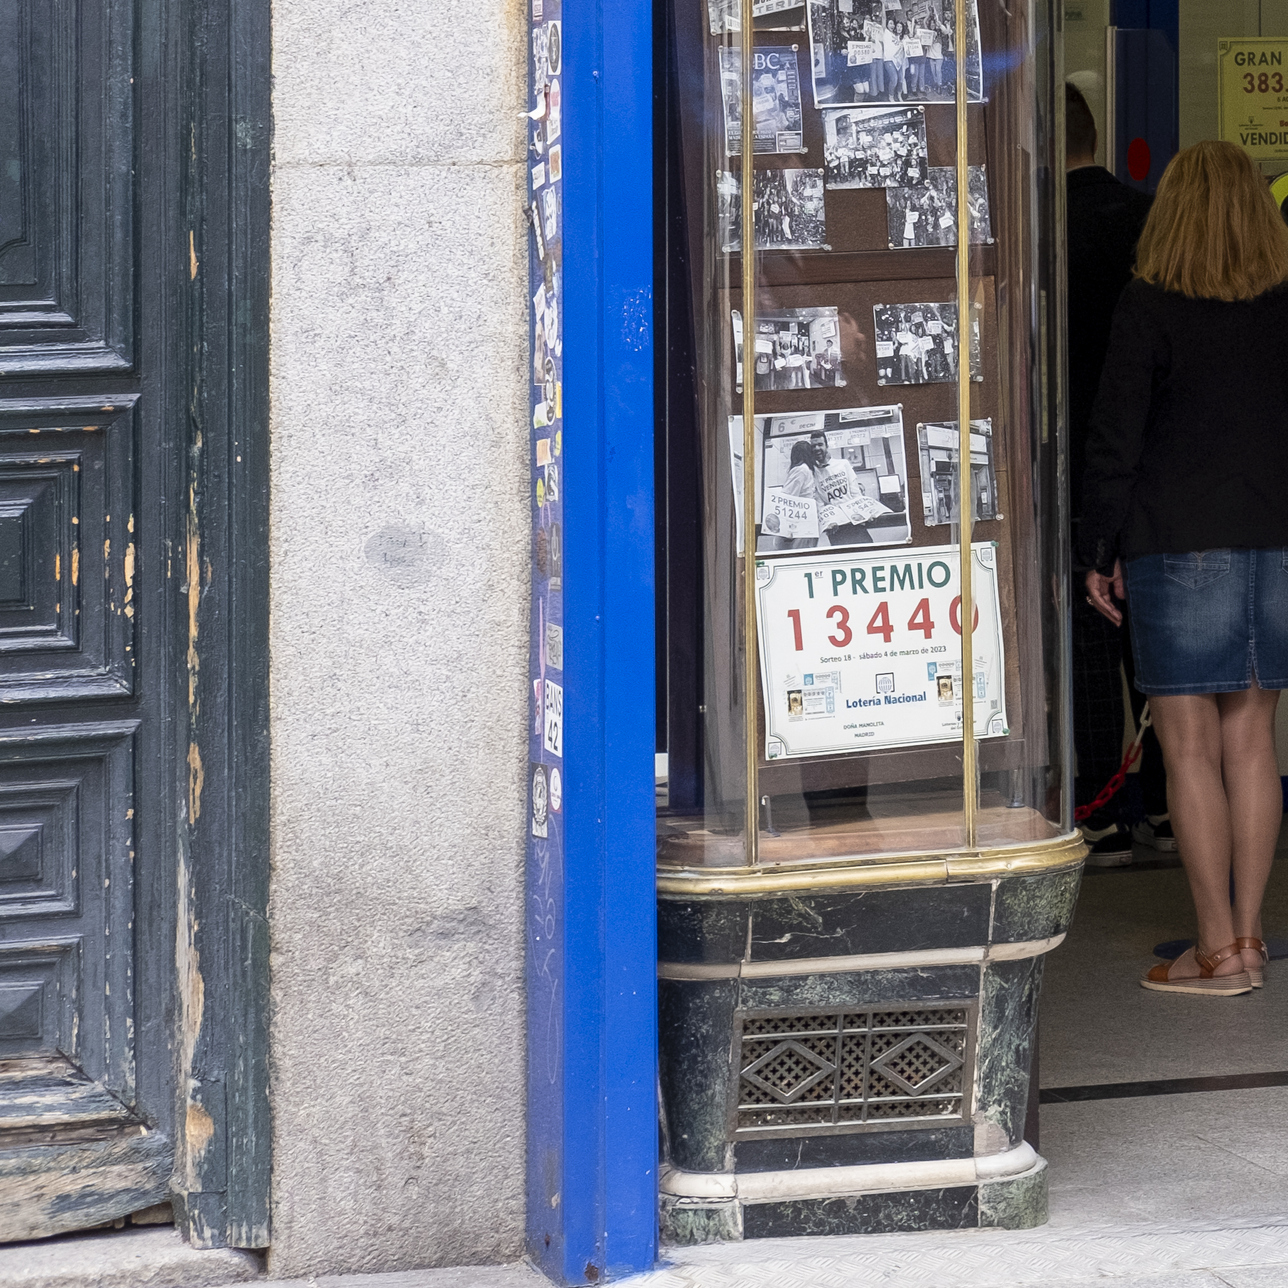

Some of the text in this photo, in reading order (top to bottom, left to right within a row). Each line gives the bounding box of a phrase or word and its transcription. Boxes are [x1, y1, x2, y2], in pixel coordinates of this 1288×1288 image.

[1234, 51, 1282, 66] GRAN
[831, 560, 951, 597] PREMIO
[787, 594, 979, 651] 13440
[859, 651, 883, 660] sábado
[899, 648, 920, 656] marzo
[921, 646, 929, 654] de
[930, 645, 947, 653] 2023
[846, 691, 927, 709] Lotería Nacional
